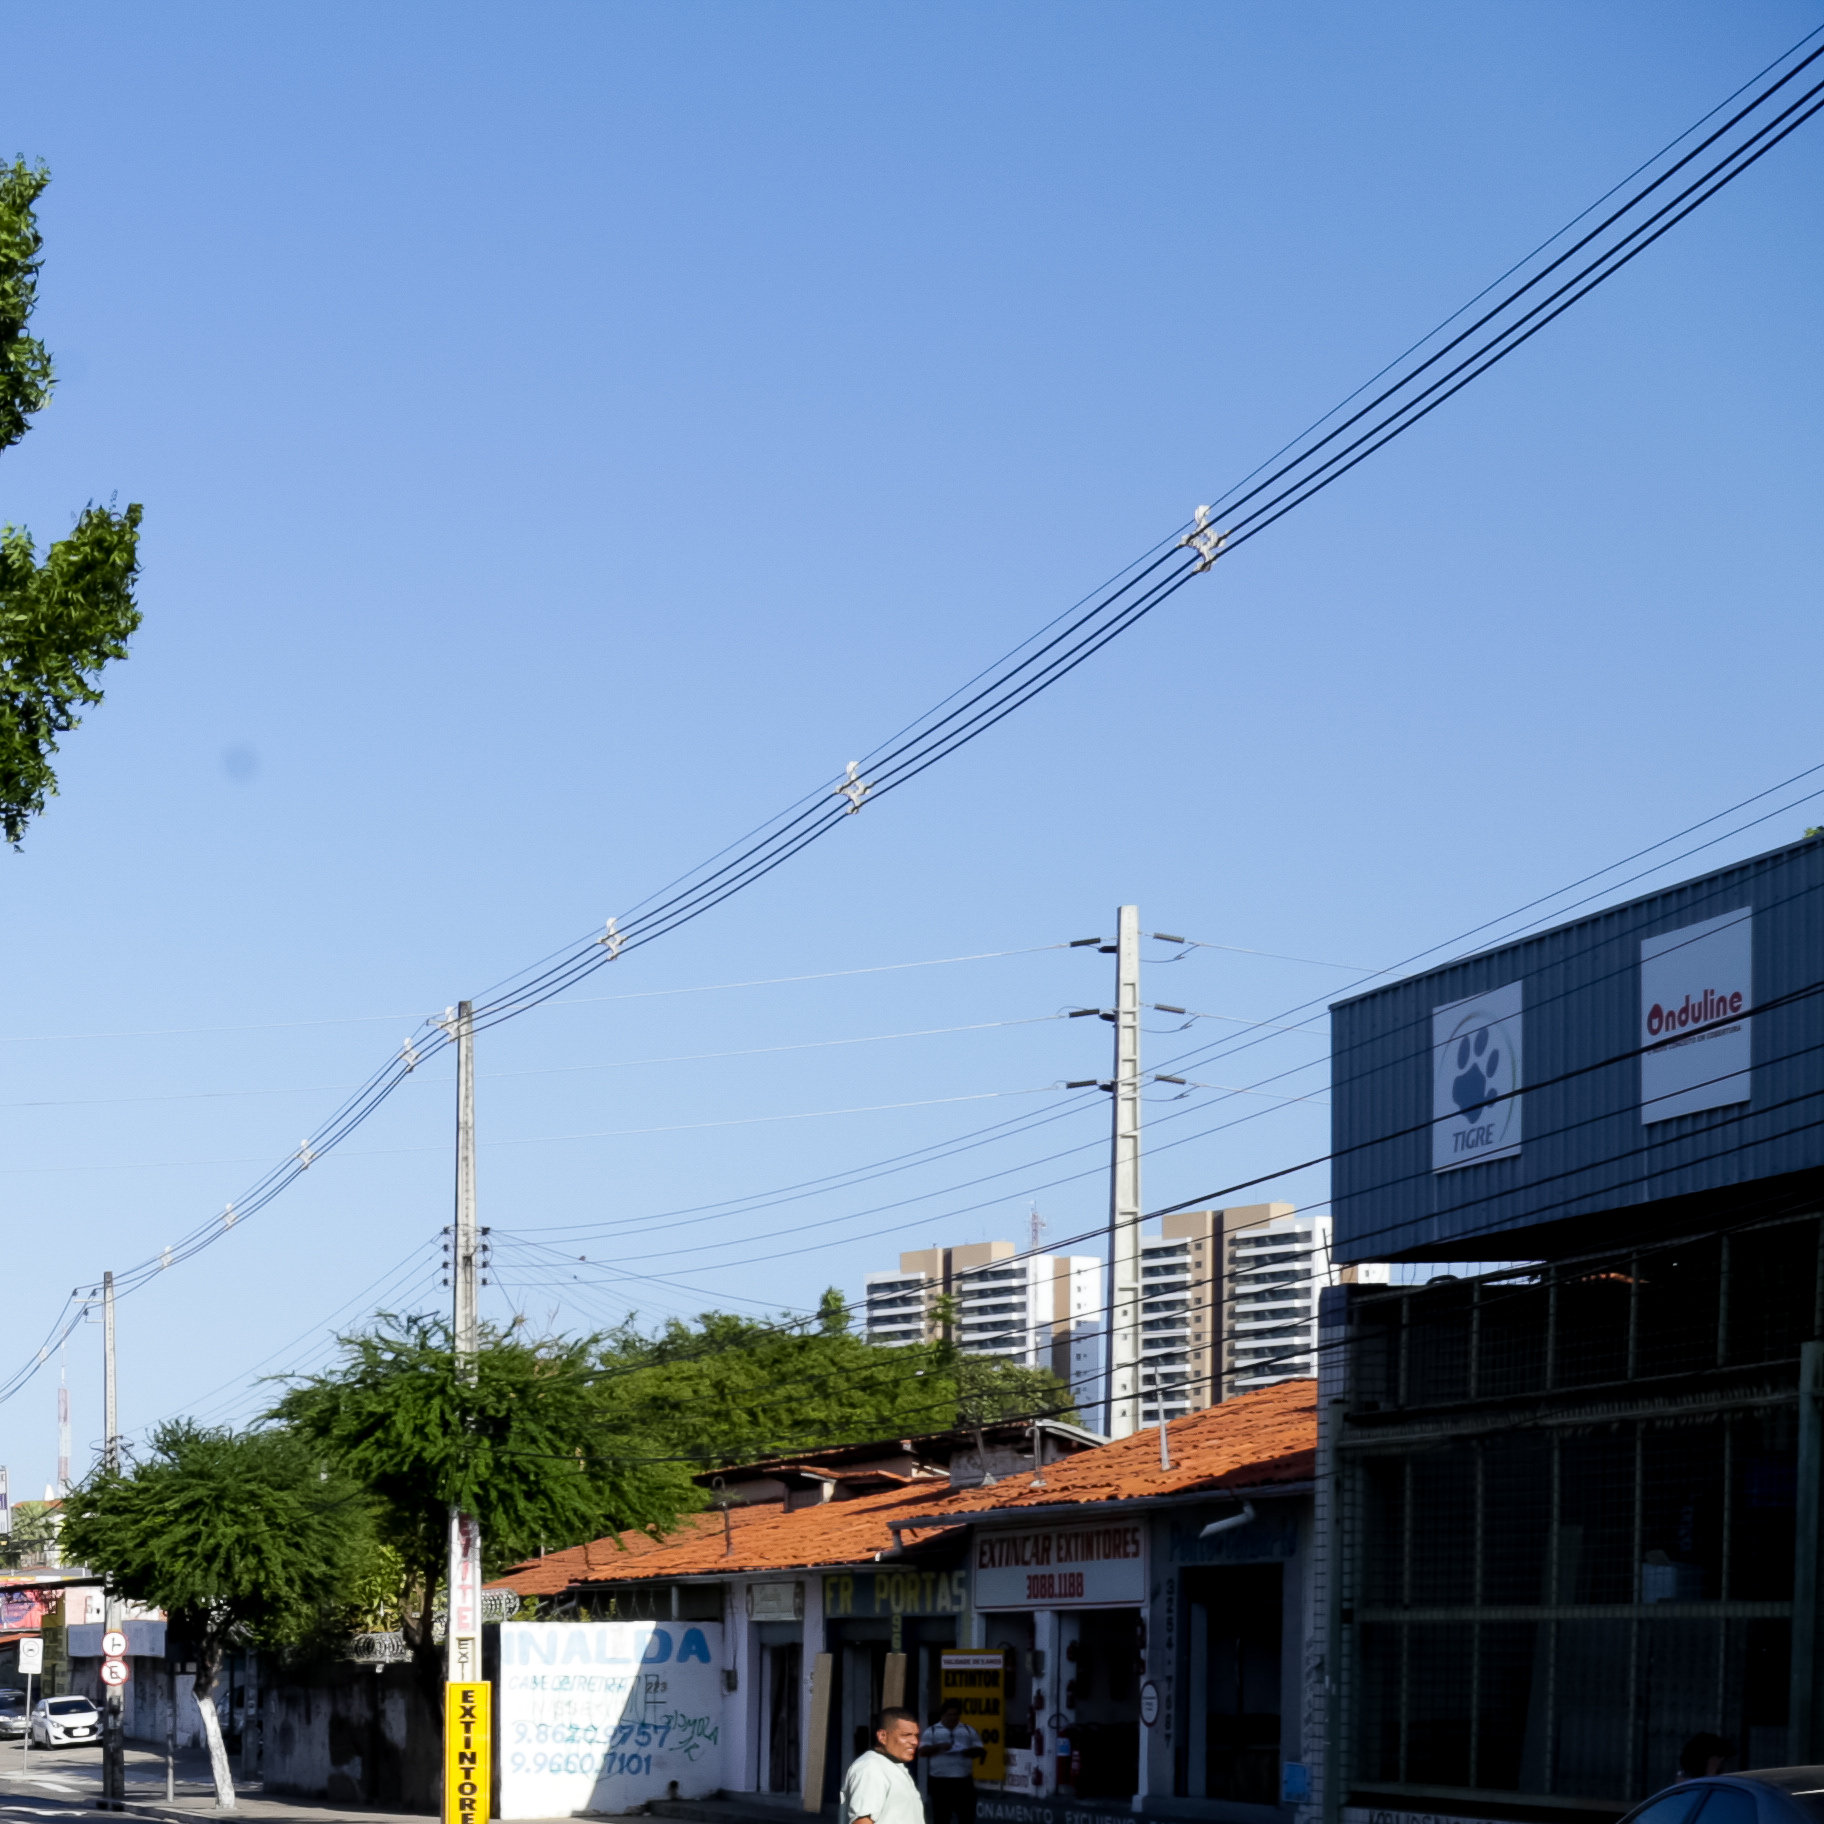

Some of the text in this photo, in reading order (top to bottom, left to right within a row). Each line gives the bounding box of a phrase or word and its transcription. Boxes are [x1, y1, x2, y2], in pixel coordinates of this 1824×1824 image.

[1647, 989, 1742, 1036] Onduline
[1453, 1123, 1496, 1153] TIGRE
[978, 1535, 1051, 1569] EXTINCAR
[1056, 1527, 1140, 1563] EXTINTORES
[874, 1571, 967, 1614] PORTAS
[1026, 1572, 1084, 1599] 3088.1188
[945, 1670, 1000, 1688] EXTINTOR
